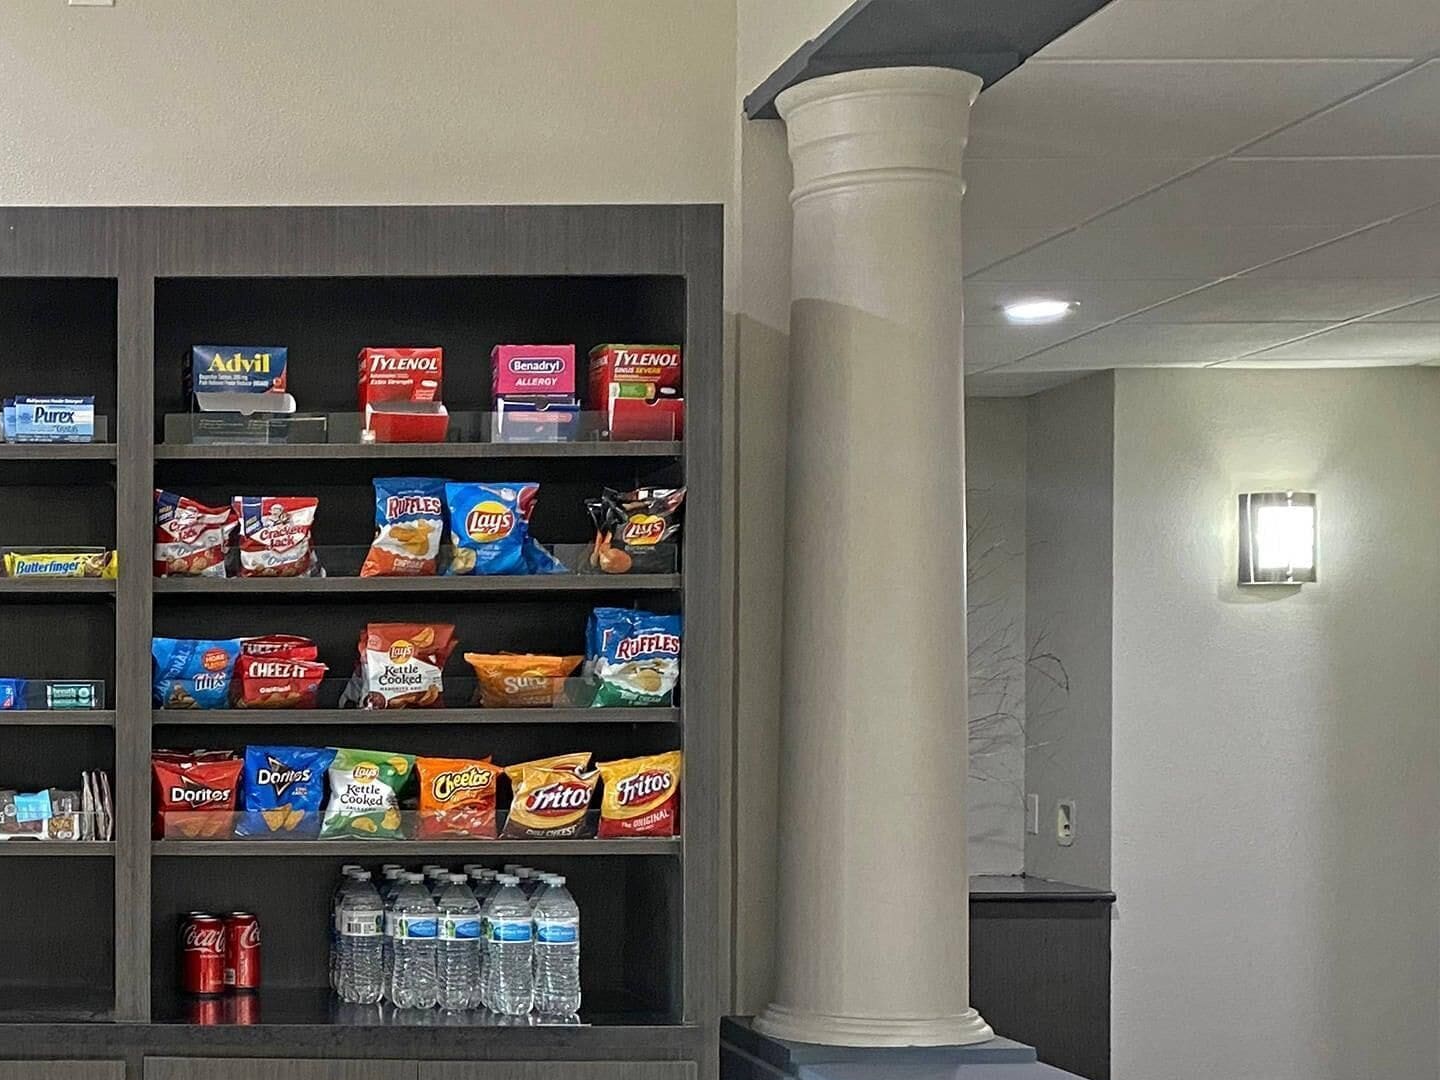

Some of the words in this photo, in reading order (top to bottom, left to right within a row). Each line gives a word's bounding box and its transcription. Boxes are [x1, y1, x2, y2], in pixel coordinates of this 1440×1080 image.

[207, 352, 270, 372] Advil
[369, 354, 438, 372] TYLENOL
[513, 360, 560, 372] Benadryl
[613, 350, 679, 366] TYLENOL
[515, 378, 558, 386] ALLERGY
[33, 406, 75, 424] Purex
[387, 496, 442, 519] RUFFLES
[15, 560, 81, 575] Butterfinger
[615, 633, 680, 660] RUFFLES
[249, 661, 308, 678] CHEEZ-IT
[384, 664, 418, 677] Kettle
[378, 674, 422, 686] Cooked
[258, 769, 311, 785] Doritos
[434, 767, 492, 800] Cheetos
[171, 787, 231, 802] Doritos
[346, 784, 380, 797] Kettle
[616, 772, 671, 805] Fritos
[340, 794, 383, 807] Cooked
[526, 783, 593, 811] Fritos
[633, 810, 671, 828] ORIGINAL
